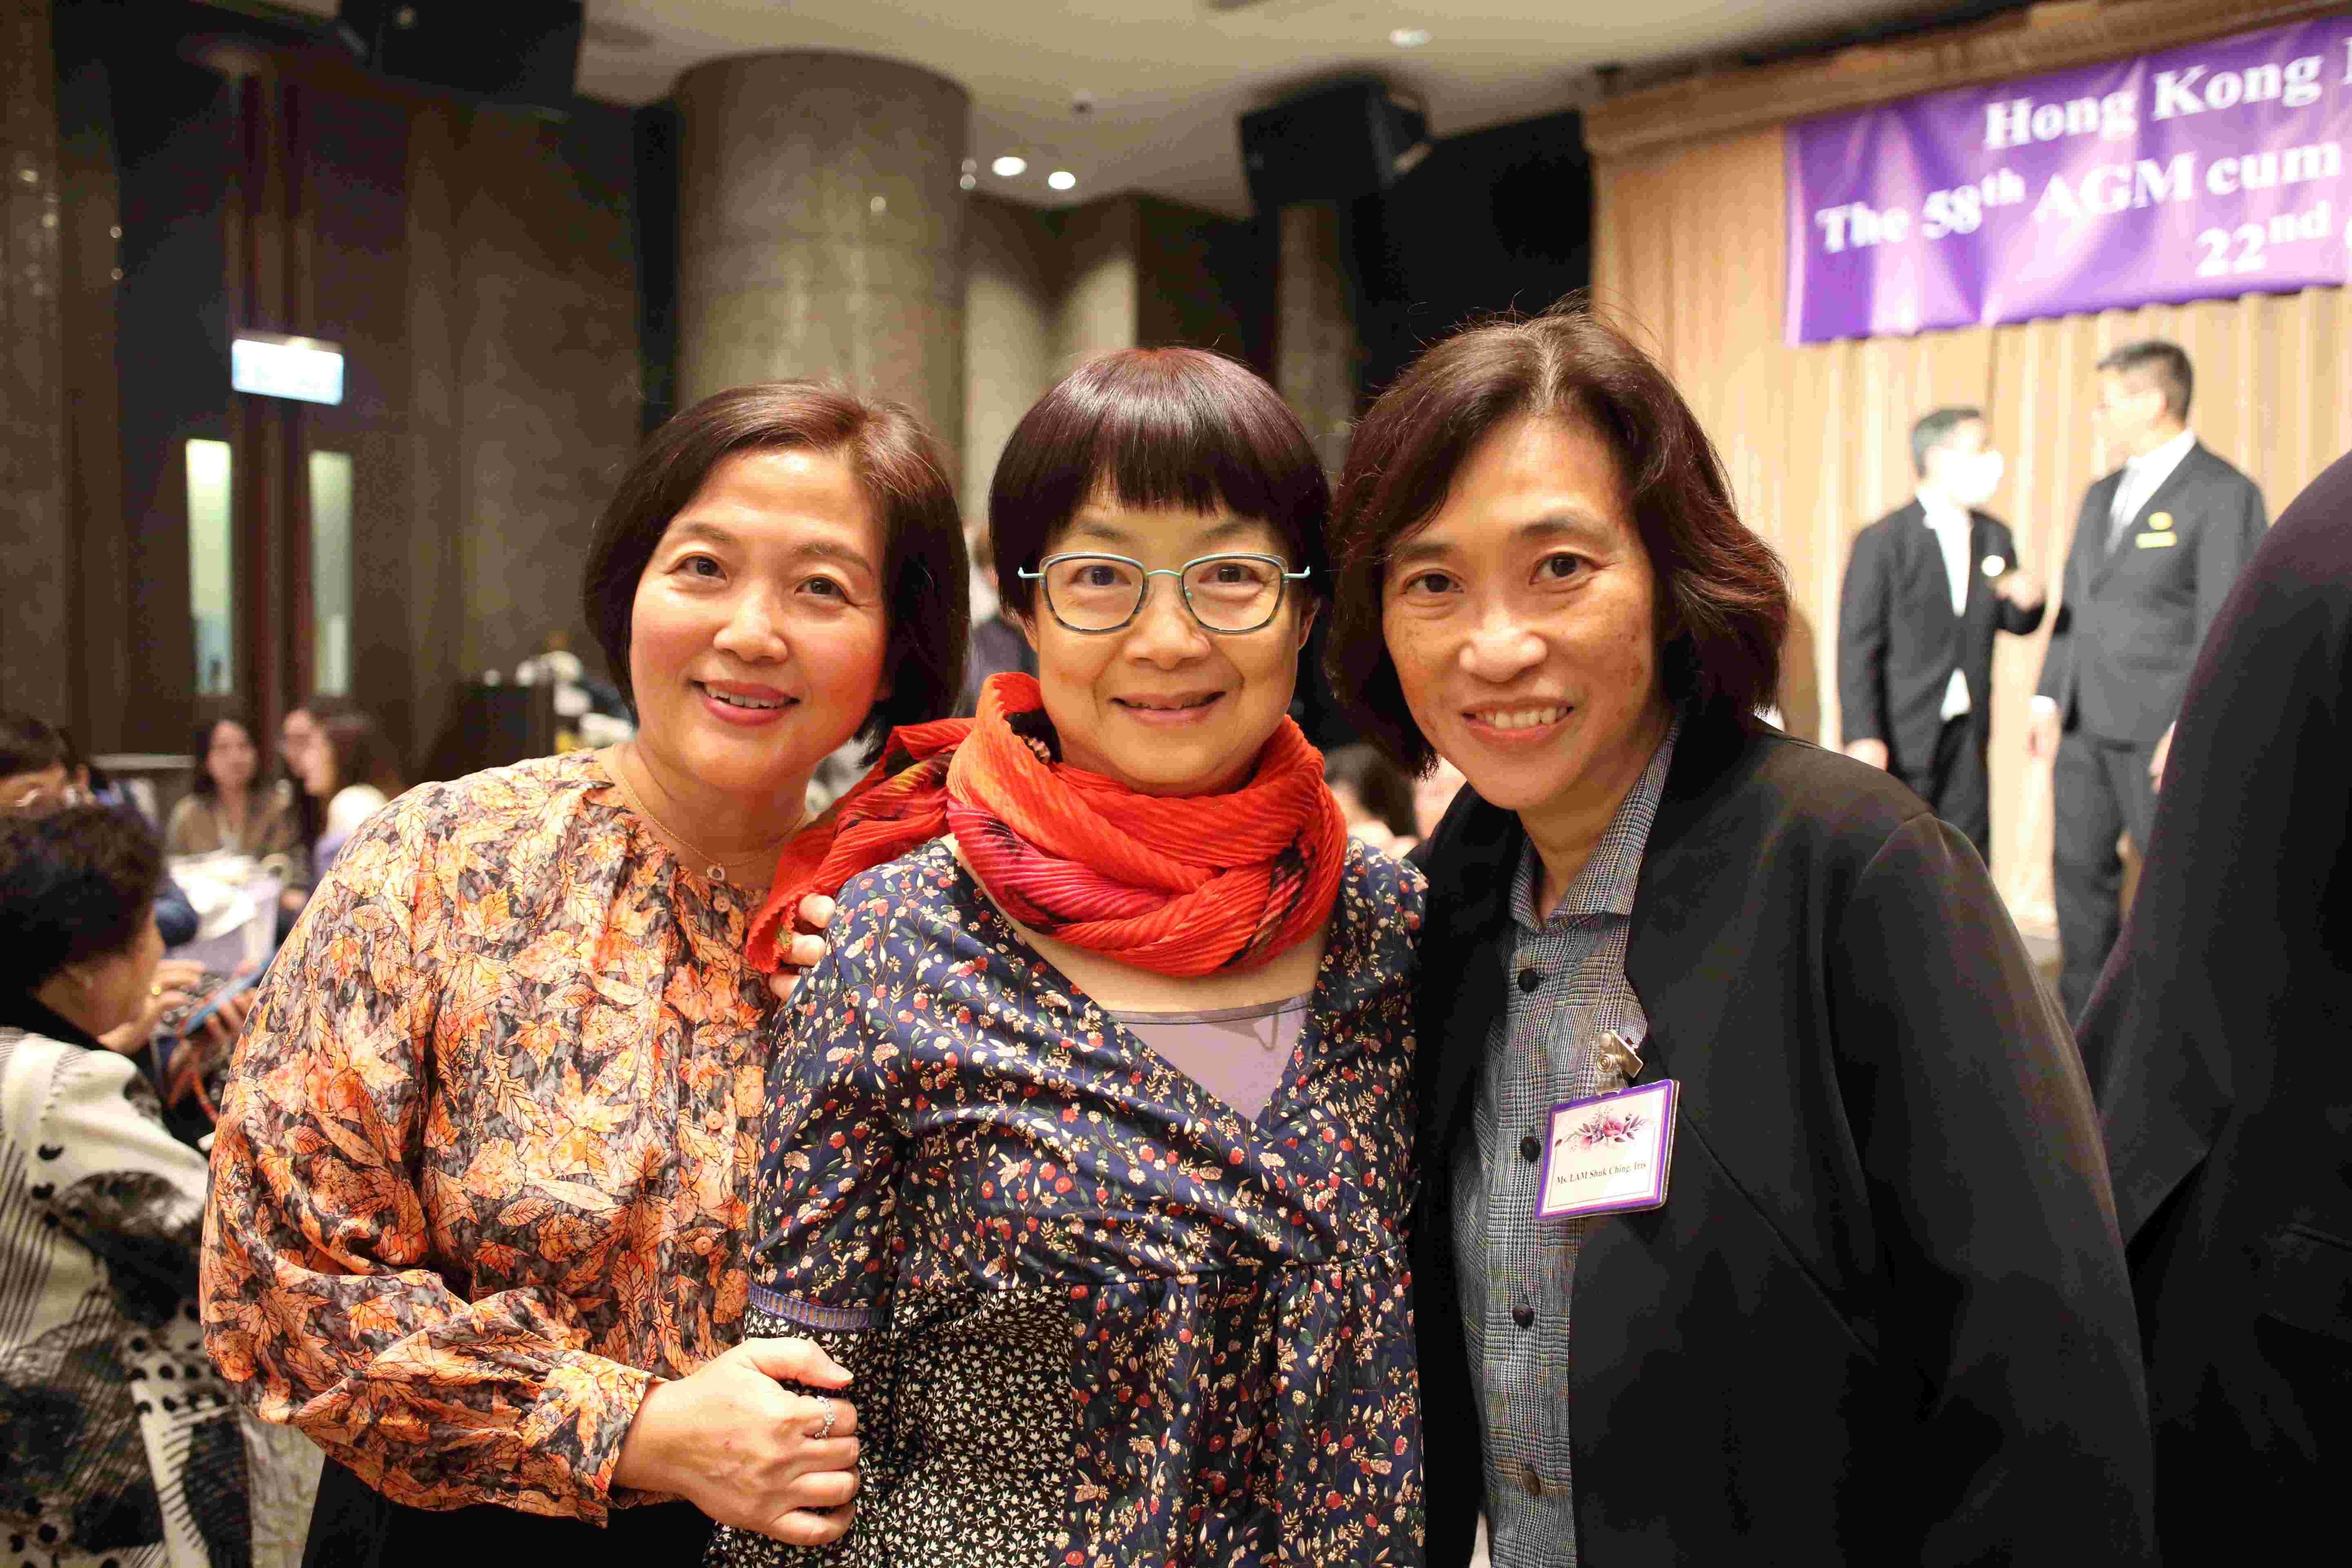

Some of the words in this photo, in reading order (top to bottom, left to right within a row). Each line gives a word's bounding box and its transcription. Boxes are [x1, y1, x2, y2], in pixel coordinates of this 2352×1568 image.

[1984, 90, 2139, 149] Hong
[2152, 54, 2324, 120] Kong
[1815, 202, 1910, 253] The
[1921, 167, 2027, 240] 58th
[2033, 152, 2197, 222] AGM
[2205, 142, 2342, 195] cum
[2194, 200, 2333, 278] 22nd
[1570, 1172, 1587, 1182] LAM
[1590, 1167, 1607, 1178] Shuk
